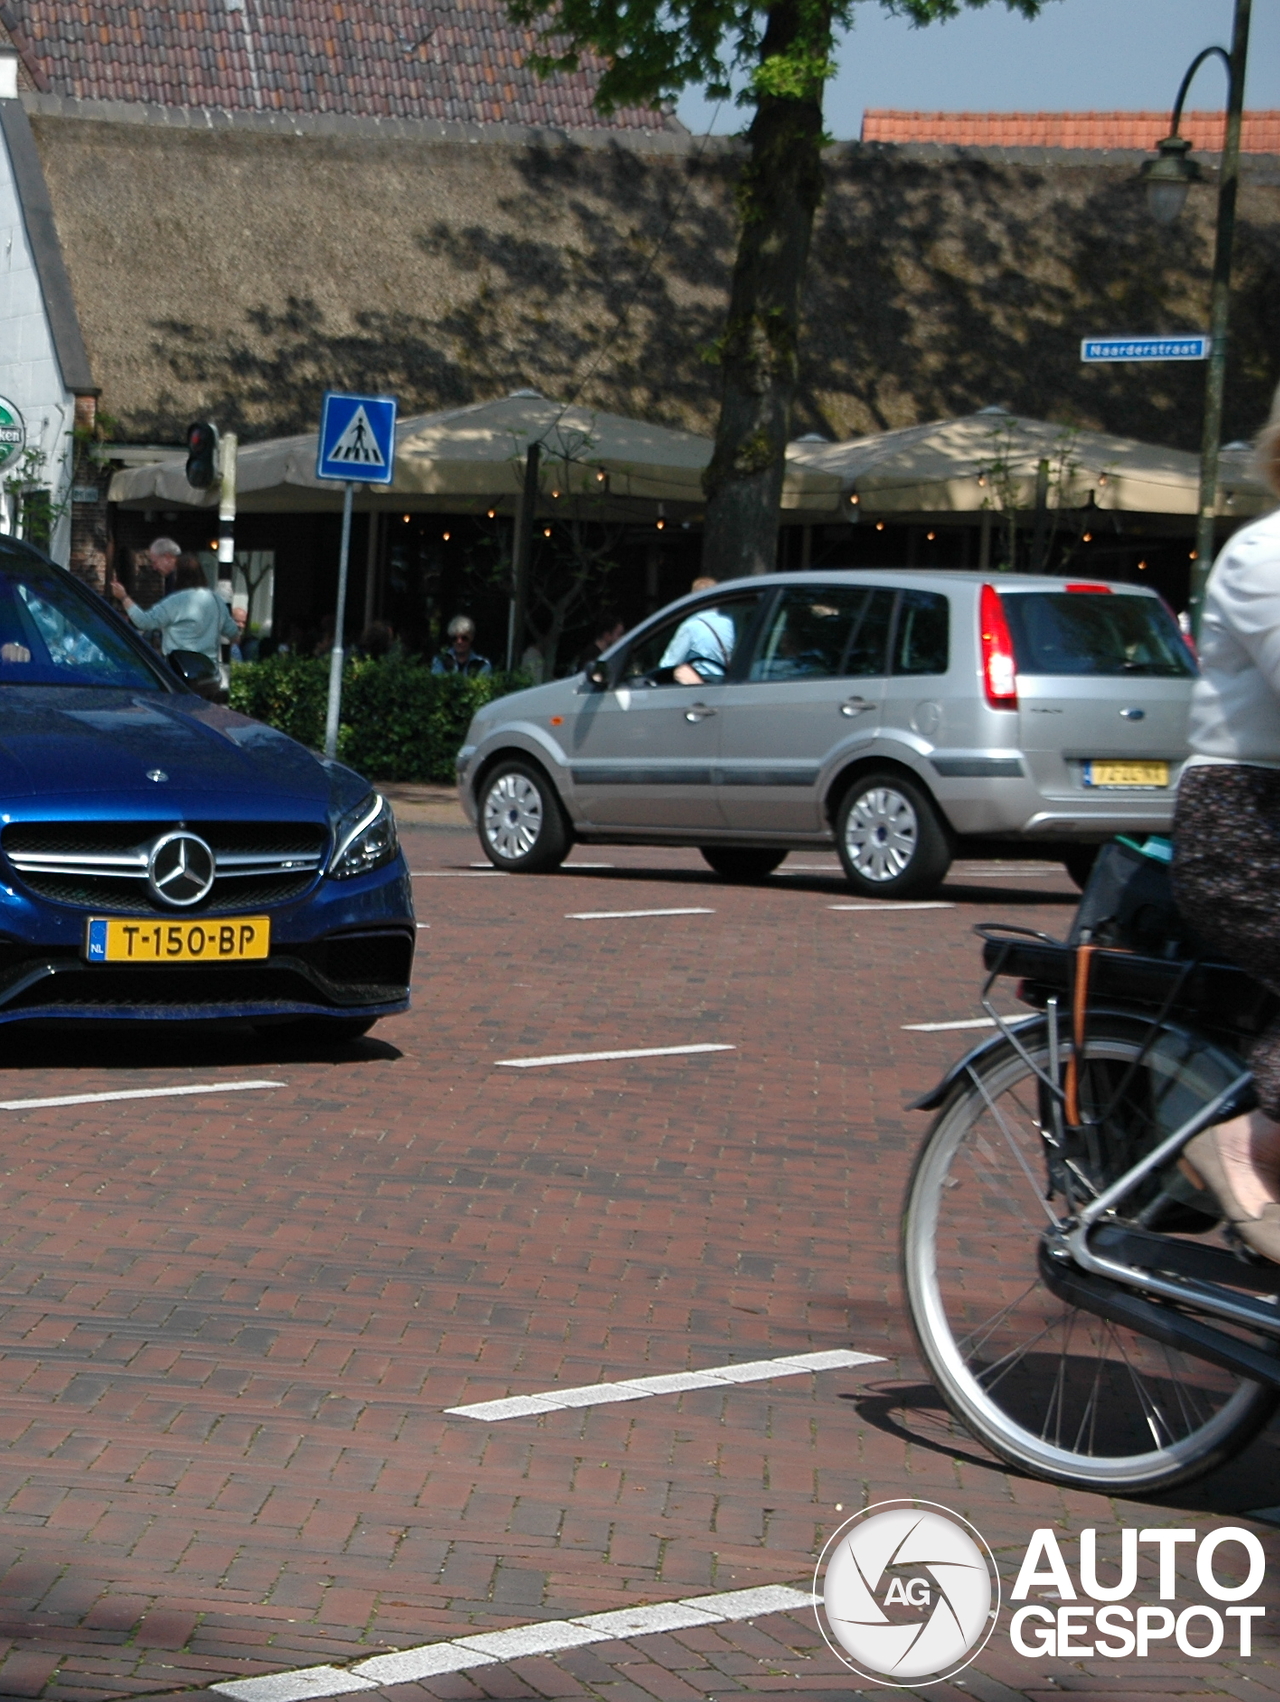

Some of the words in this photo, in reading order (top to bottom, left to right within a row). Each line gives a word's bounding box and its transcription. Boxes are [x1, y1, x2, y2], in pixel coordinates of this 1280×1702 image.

[1090, 342, 1197, 357] Naarderstraat
[90, 943, 104, 954] NL
[122, 925, 256, 957] T-150-BP
